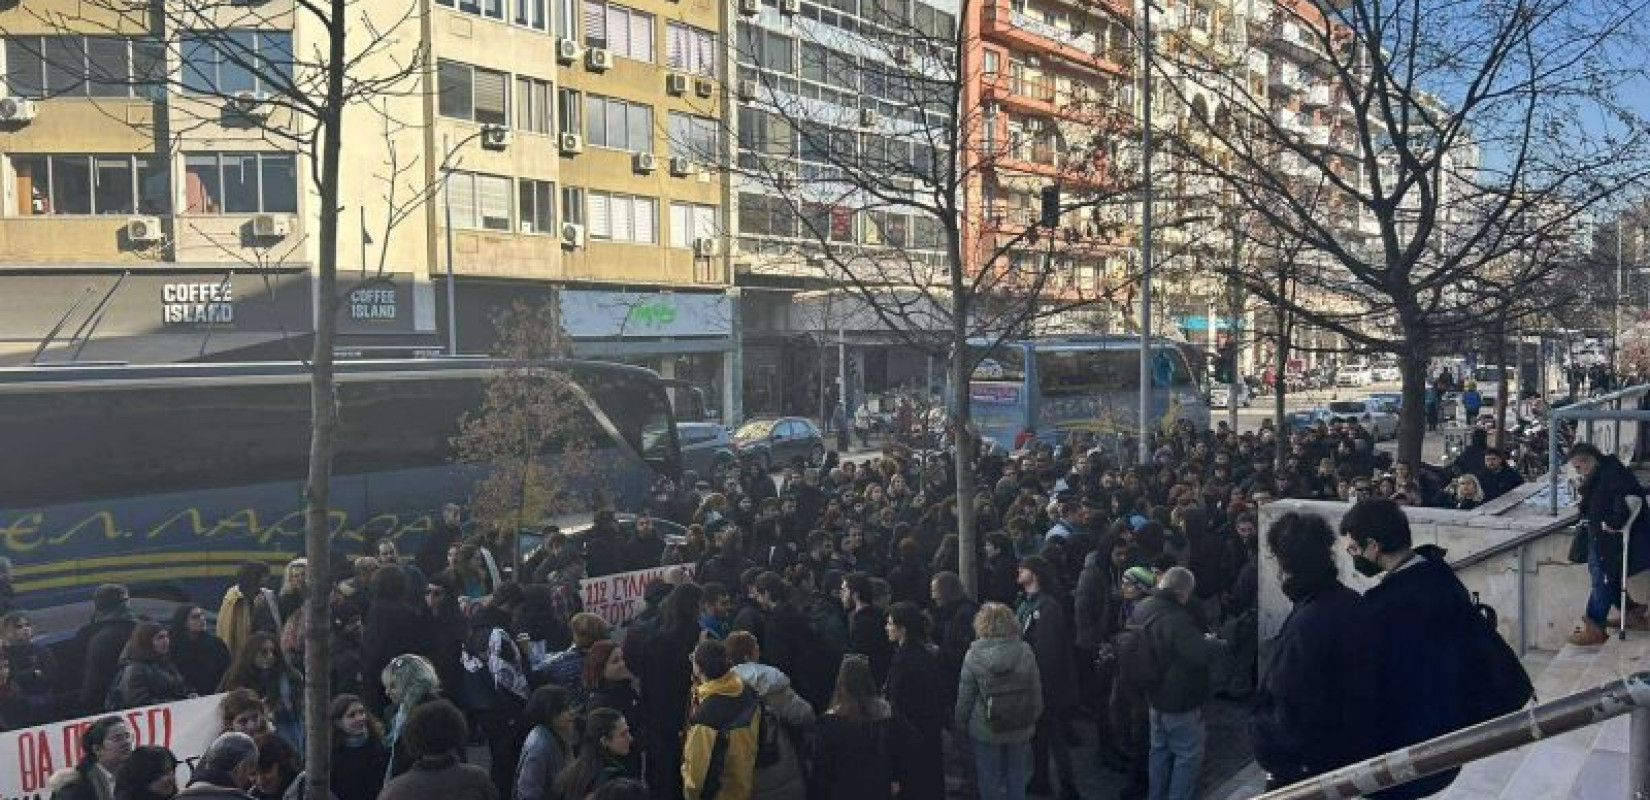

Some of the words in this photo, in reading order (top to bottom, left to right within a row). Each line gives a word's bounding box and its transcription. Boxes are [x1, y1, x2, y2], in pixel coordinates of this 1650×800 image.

[163, 283, 232, 302] COFFEE
[352, 289, 396, 304] COFFEE
[163, 303, 233, 323] ISLAND
[352, 305, 396, 319] ISLAND
[18, 729, 53, 792] ΘΑ
